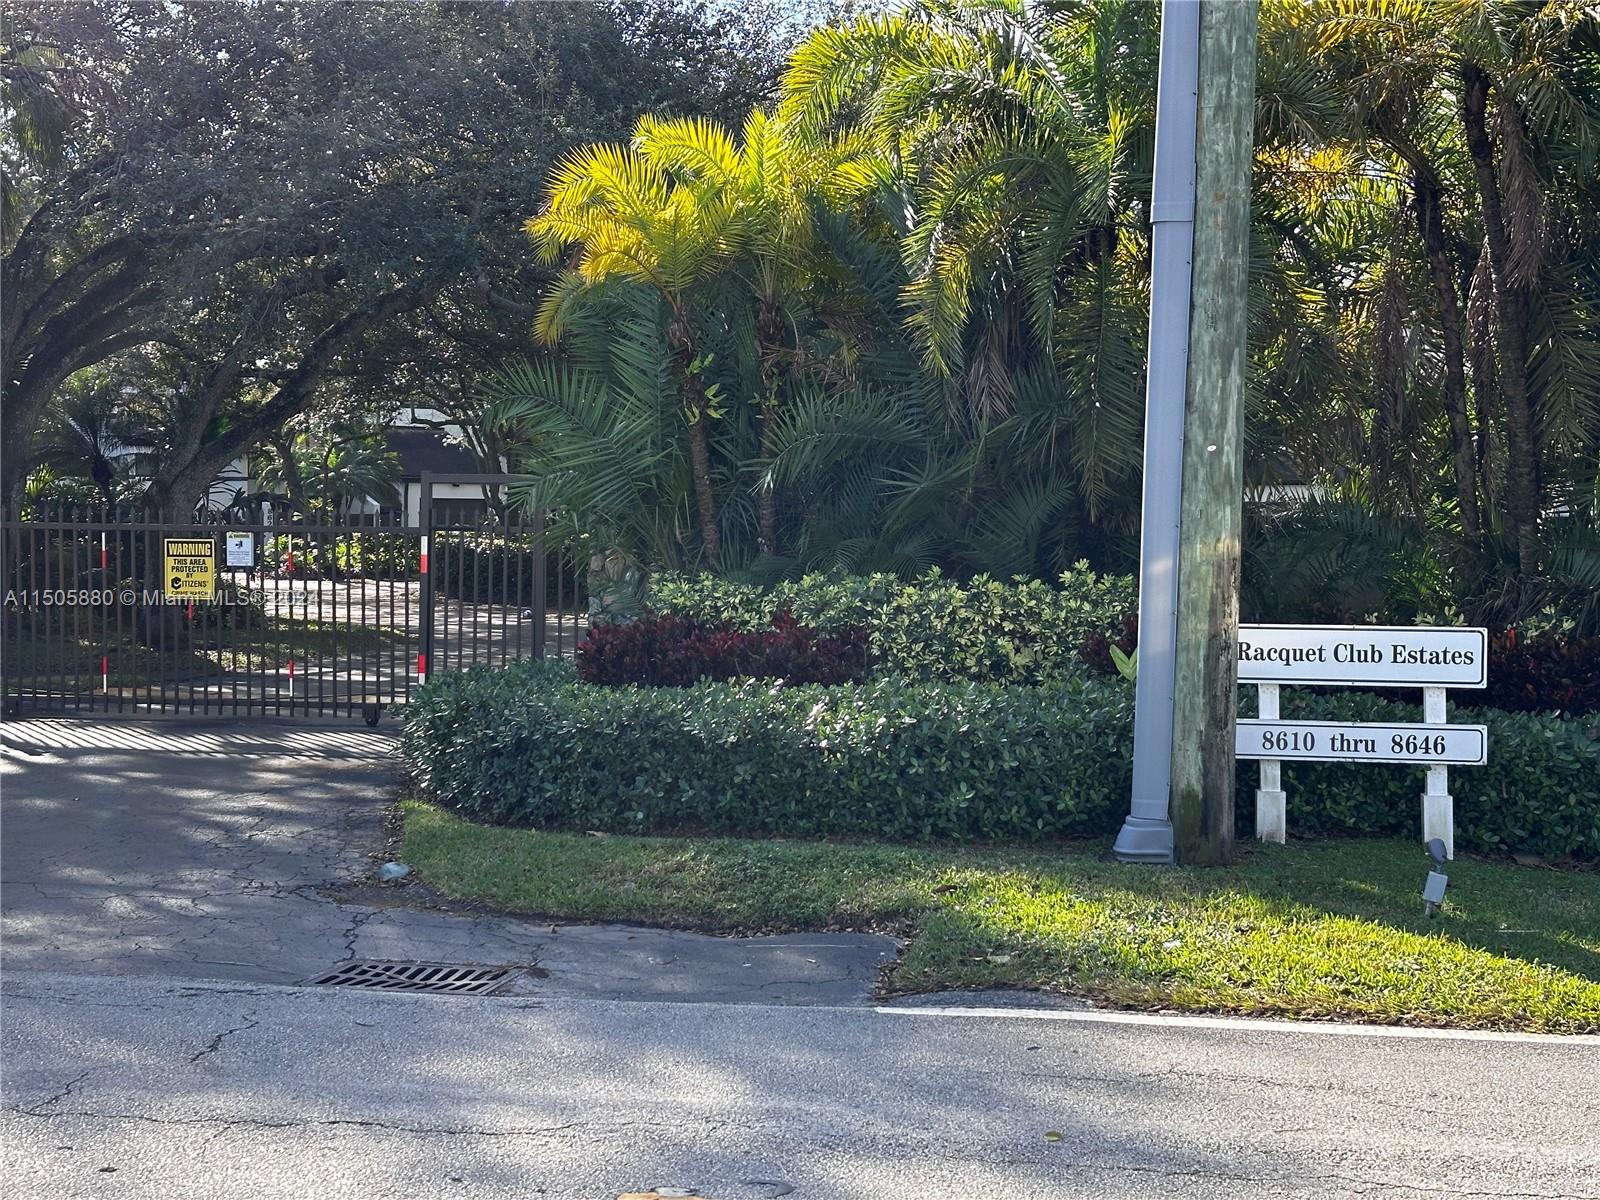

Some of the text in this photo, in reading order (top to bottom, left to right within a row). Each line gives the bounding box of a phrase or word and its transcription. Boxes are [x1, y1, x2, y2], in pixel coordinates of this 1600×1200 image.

[168, 543, 211, 556] WARNING
[1237, 641, 1474, 666] Racquet Club Estates
[1262, 731, 1446, 755] 8610 thru 8646
